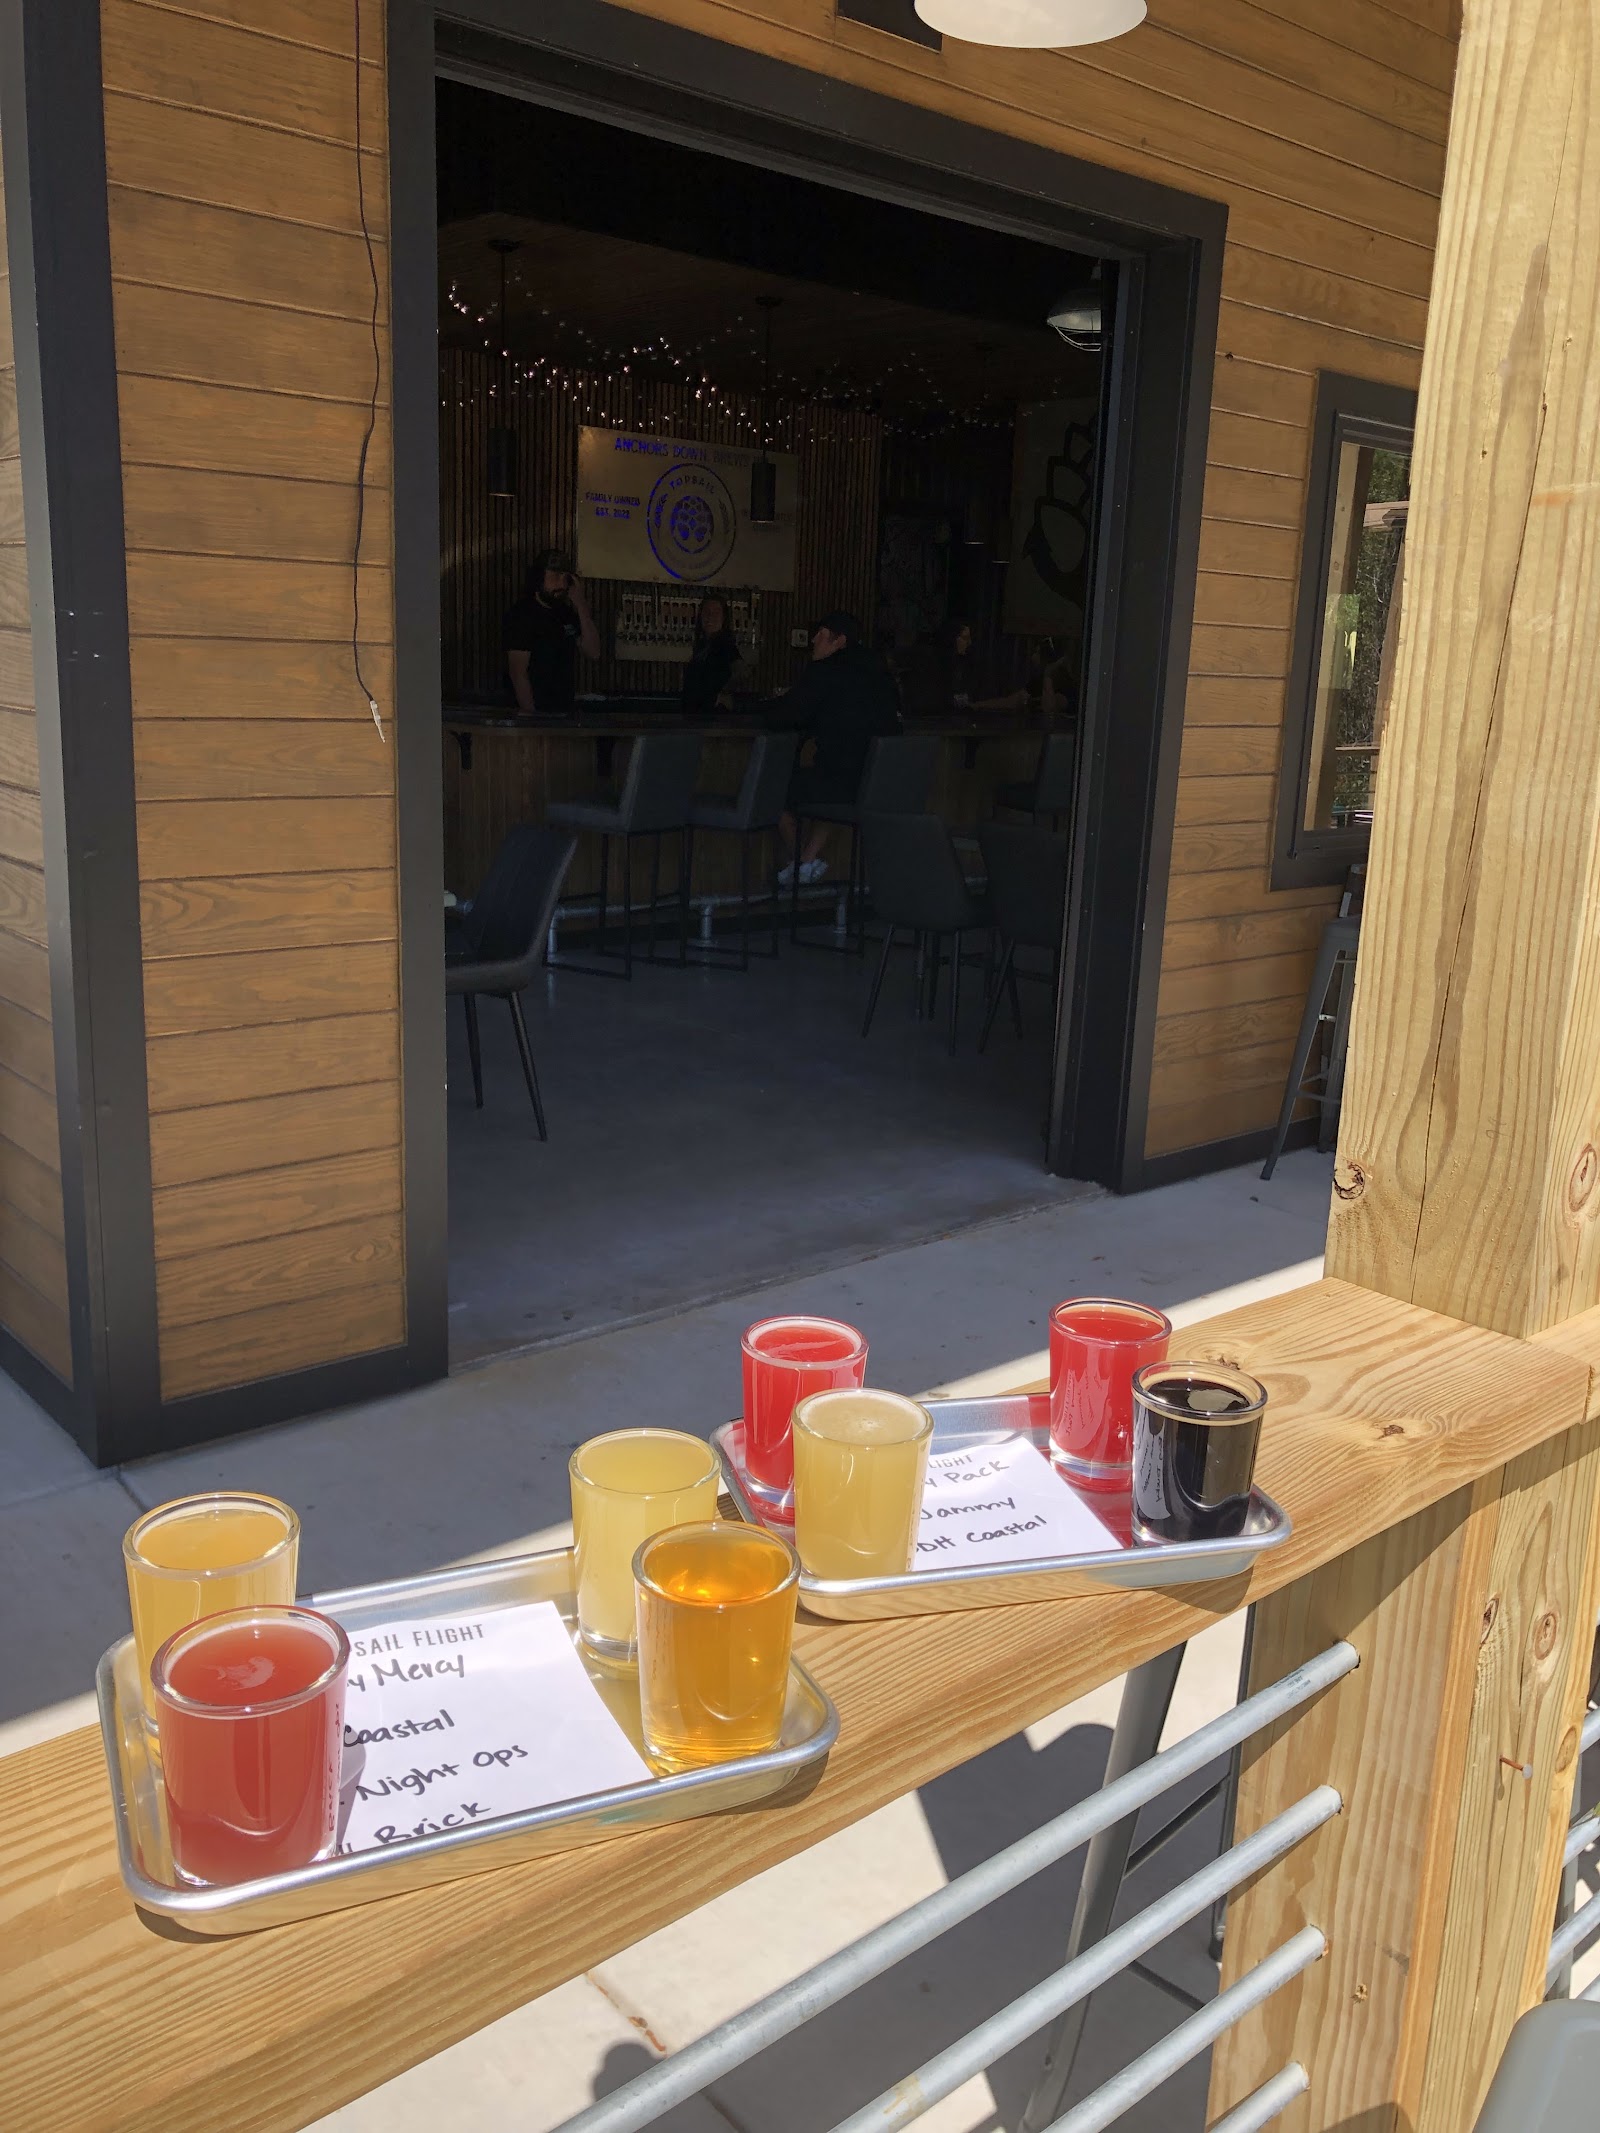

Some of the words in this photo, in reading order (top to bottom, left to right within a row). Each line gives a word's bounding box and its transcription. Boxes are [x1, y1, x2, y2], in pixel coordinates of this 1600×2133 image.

[614, 437, 669, 457] ANCHORS
[673, 446, 708, 462] DOWN
[668, 474, 716, 494] TOPSAIL
[927, 1454, 973, 1469] LIGHT
[943, 1460, 1010, 1484] Pack
[916, 1535, 957, 1553] DH
[966, 1514, 1047, 1543] Coastal
[353, 1633, 404, 1658] SAIL
[411, 1623, 486, 1647] FLIGHT
[343, 1707, 455, 1748] Coastal
[355, 1762, 460, 1802] Night
[472, 1744, 529, 1768] Ops
[373, 1801, 492, 1845] Brick
